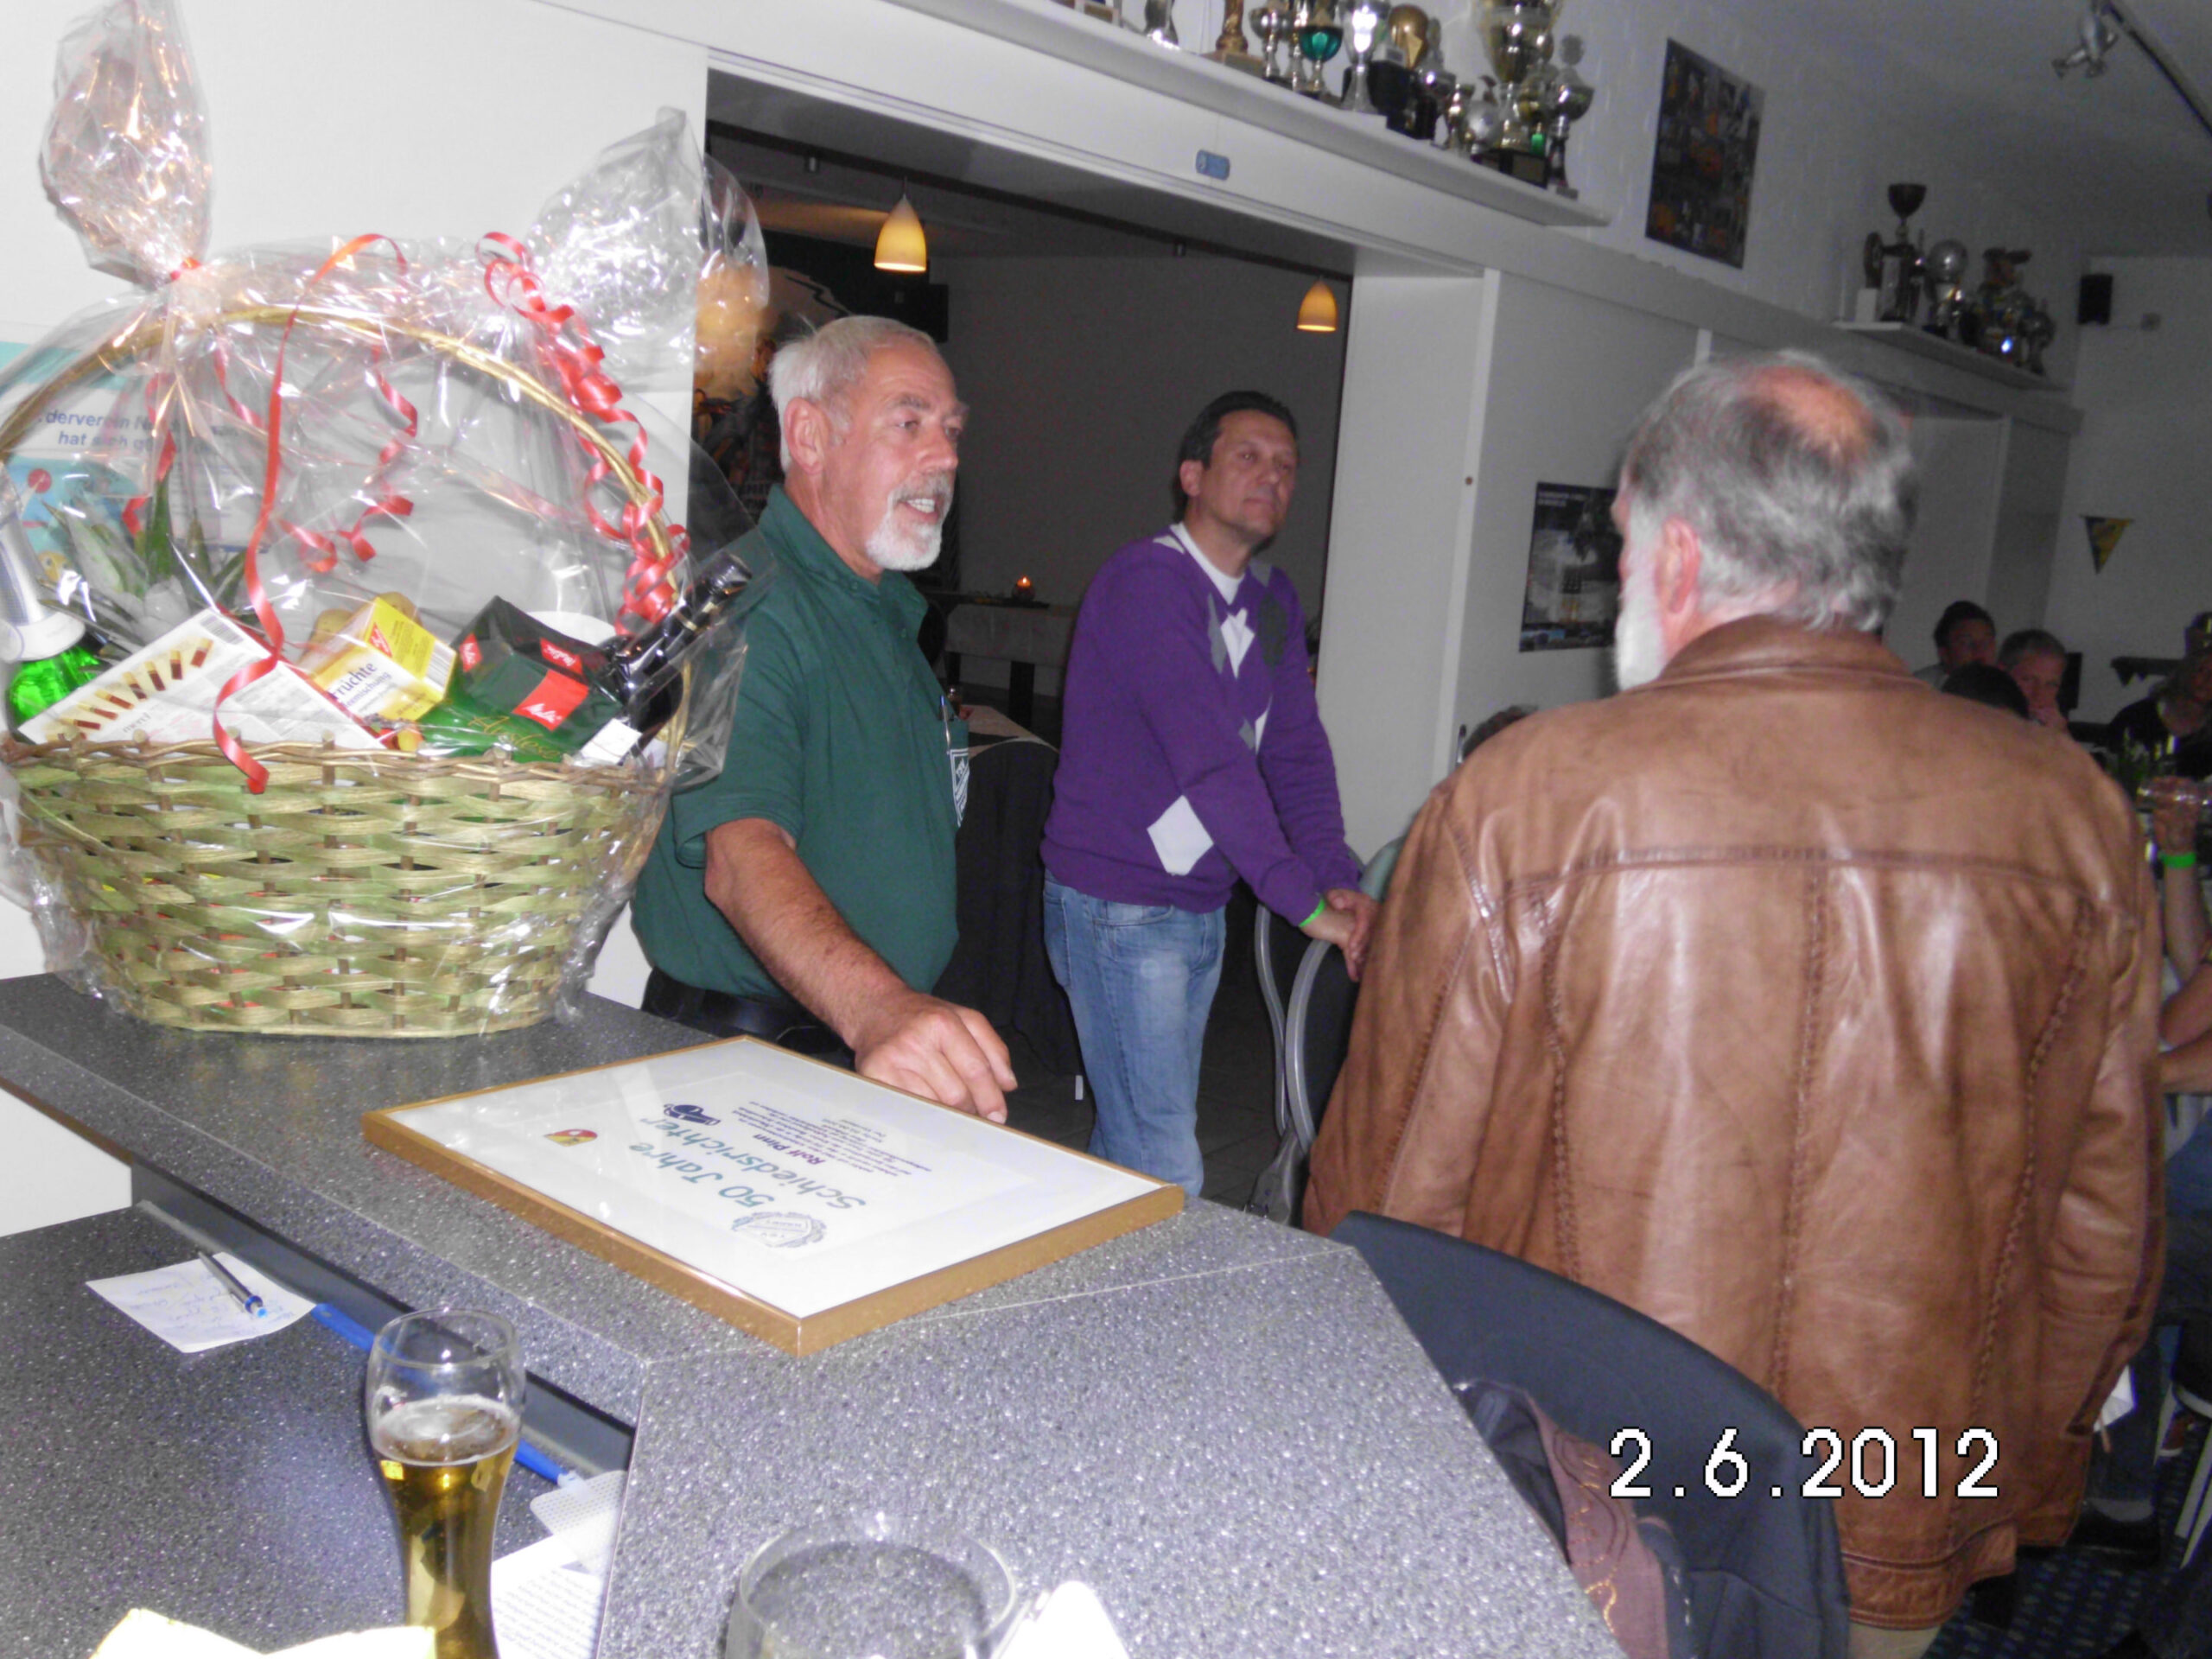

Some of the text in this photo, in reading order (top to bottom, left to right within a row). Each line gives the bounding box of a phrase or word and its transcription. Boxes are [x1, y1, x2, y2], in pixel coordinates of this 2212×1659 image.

[58, 431, 86, 446] hat
[639, 1117, 867, 1209] Schiedsrichter
[753, 1134, 827, 1165] Rolf Pinn
[628, 1142, 775, 1208] 50 Jahre
